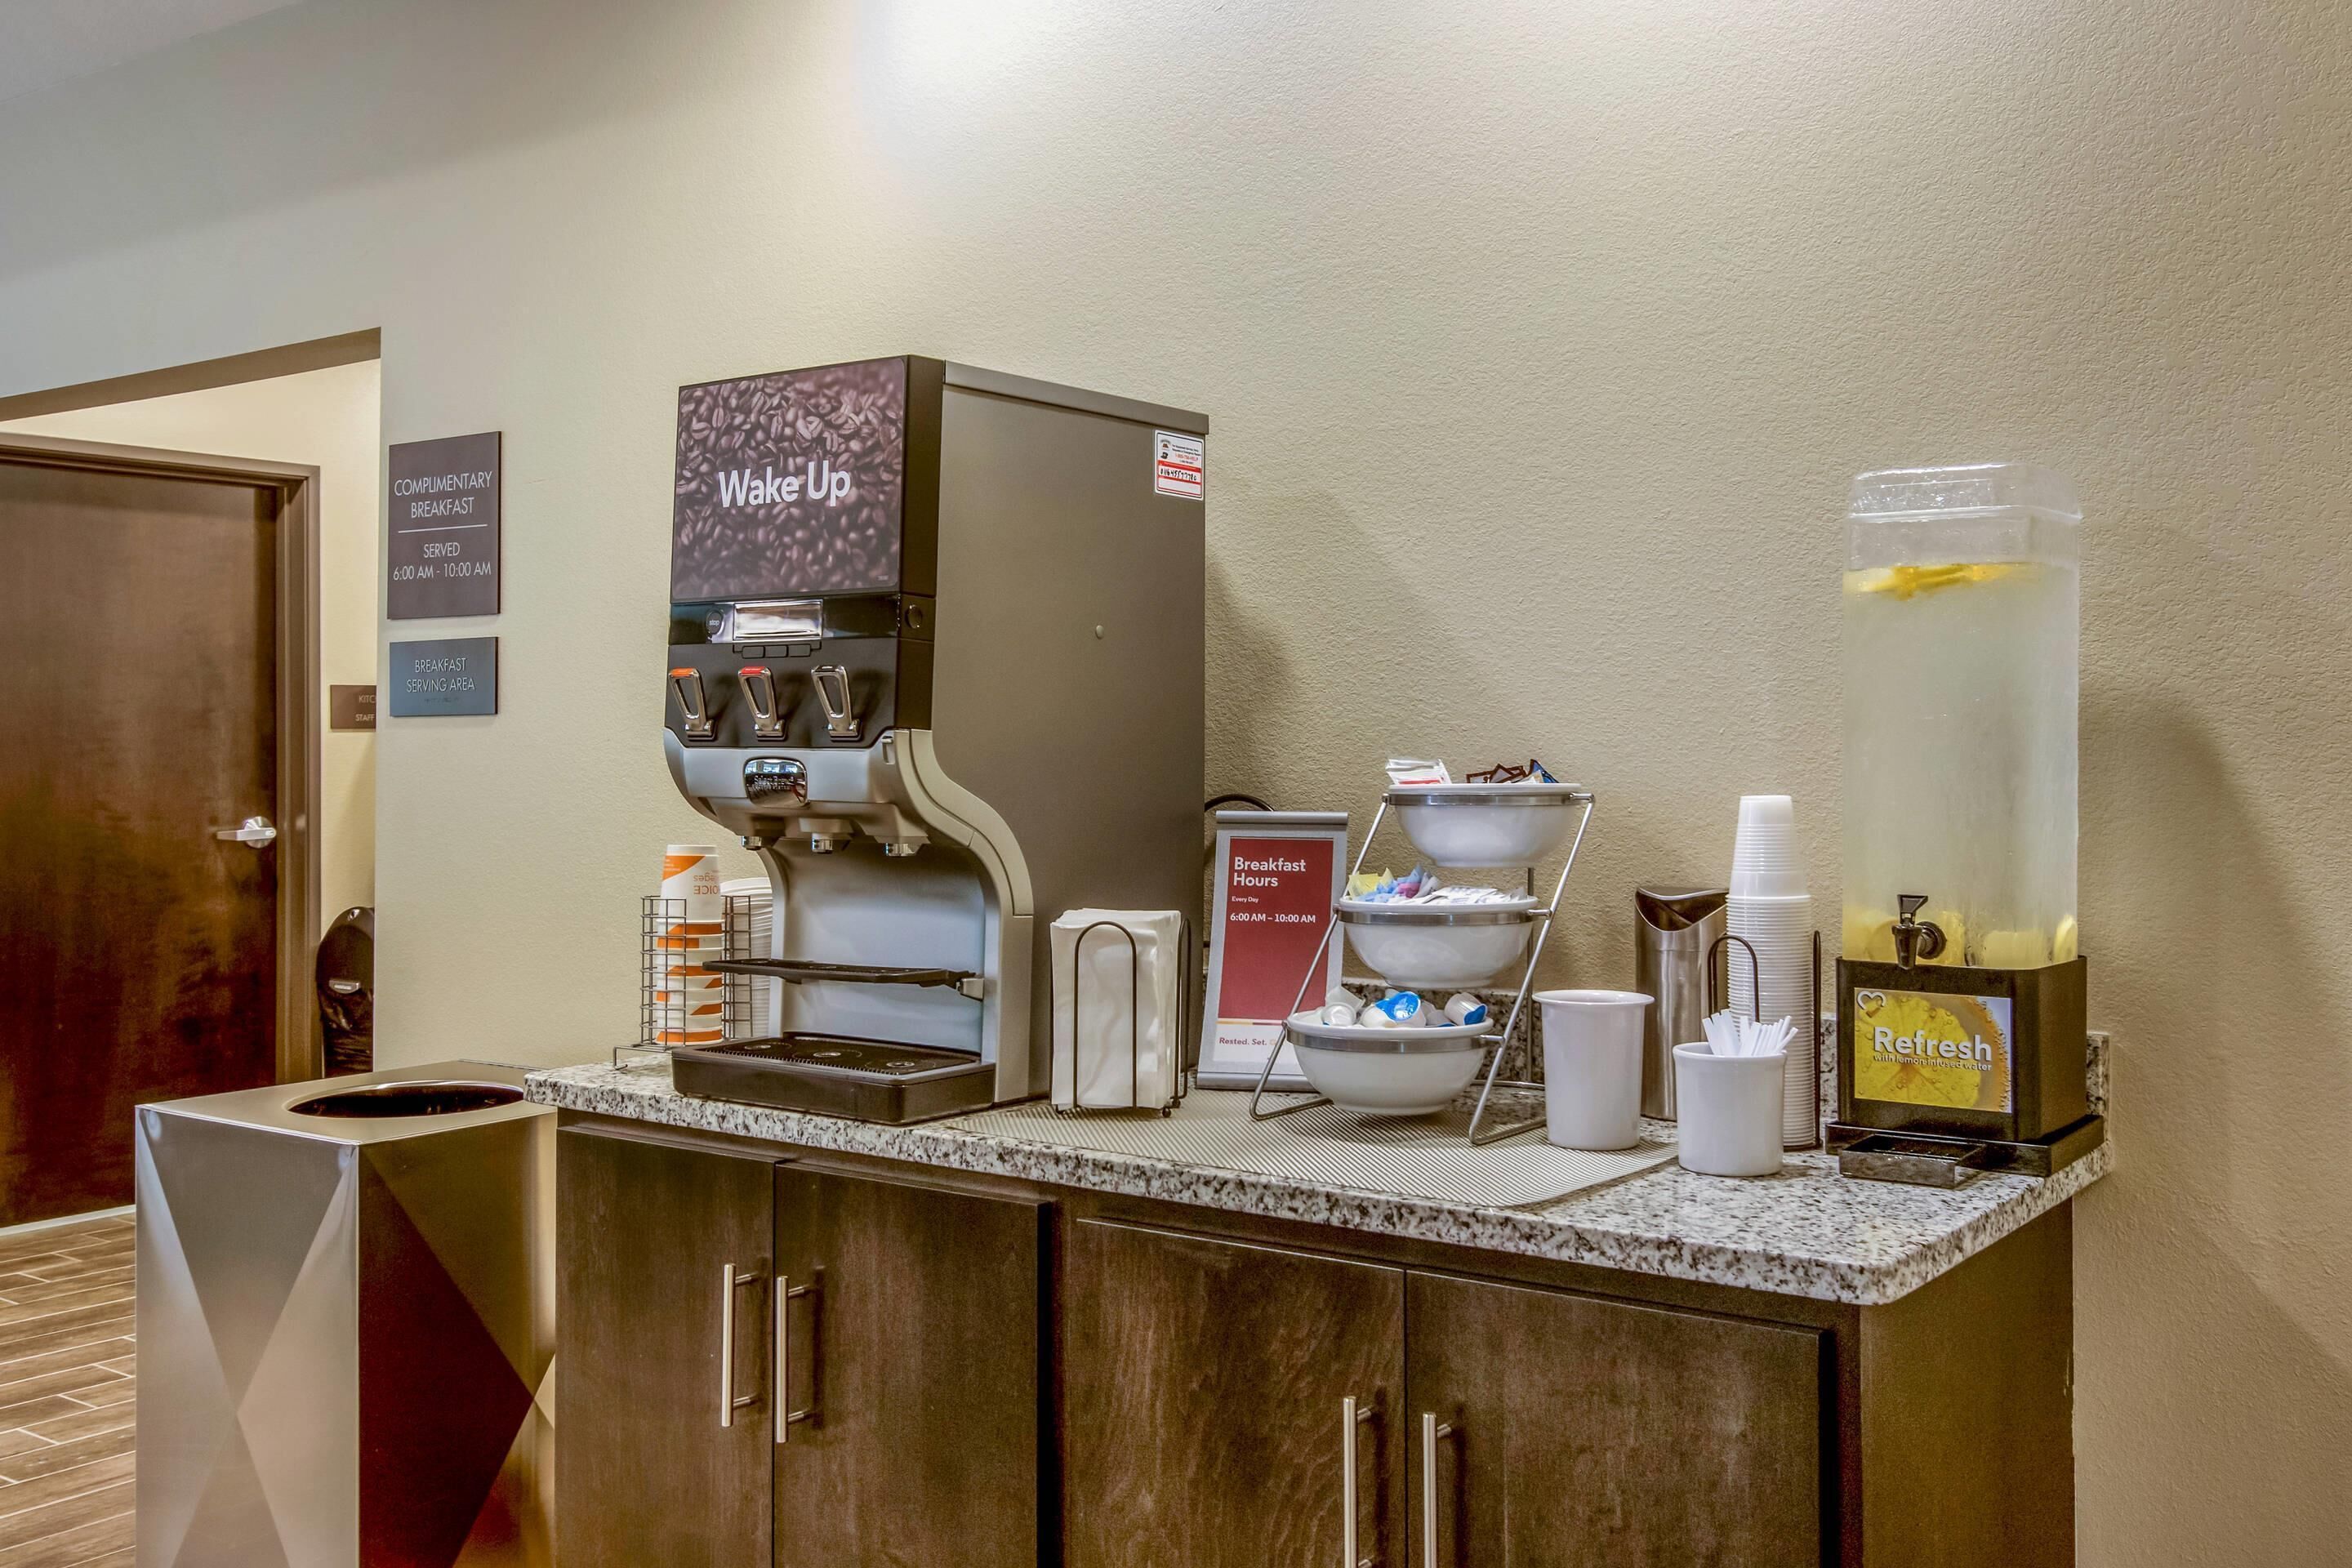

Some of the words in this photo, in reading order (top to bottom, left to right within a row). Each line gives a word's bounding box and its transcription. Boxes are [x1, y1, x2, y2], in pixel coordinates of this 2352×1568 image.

[394, 471, 492, 496] COMPLIMENTARY
[718, 466, 800, 509] Wake
[807, 460, 851, 507] Up
[411, 497, 474, 519] BREAKFAST
[423, 541, 461, 559] SERVED
[393, 564, 415, 581] 6:00
[416, 564, 434, 579] AM
[443, 561, 471, 577] 10:00
[473, 561, 492, 576] AM
[415, 657, 467, 673] BREAKFAST
[406, 678, 448, 693] SERVING
[449, 677, 475, 692] AREA
[359, 694, 376, 704] KITC
[1234, 856, 1307, 872] Breakfast
[1233, 872, 1279, 887] Hours
[693, 884, 719, 895] OICE
[1230, 912, 1250, 921] 6:00
[1250, 913, 1266, 922] AM
[1274, 913, 1299, 923] 10:00
[1300, 914, 1316, 923] AM
[1219, 1037, 1250, 1045] Rested.
[1873, 1026, 1992, 1062] Refresh
[1873, 1053, 1895, 1062] with
[1964, 1062, 1993, 1071] water
